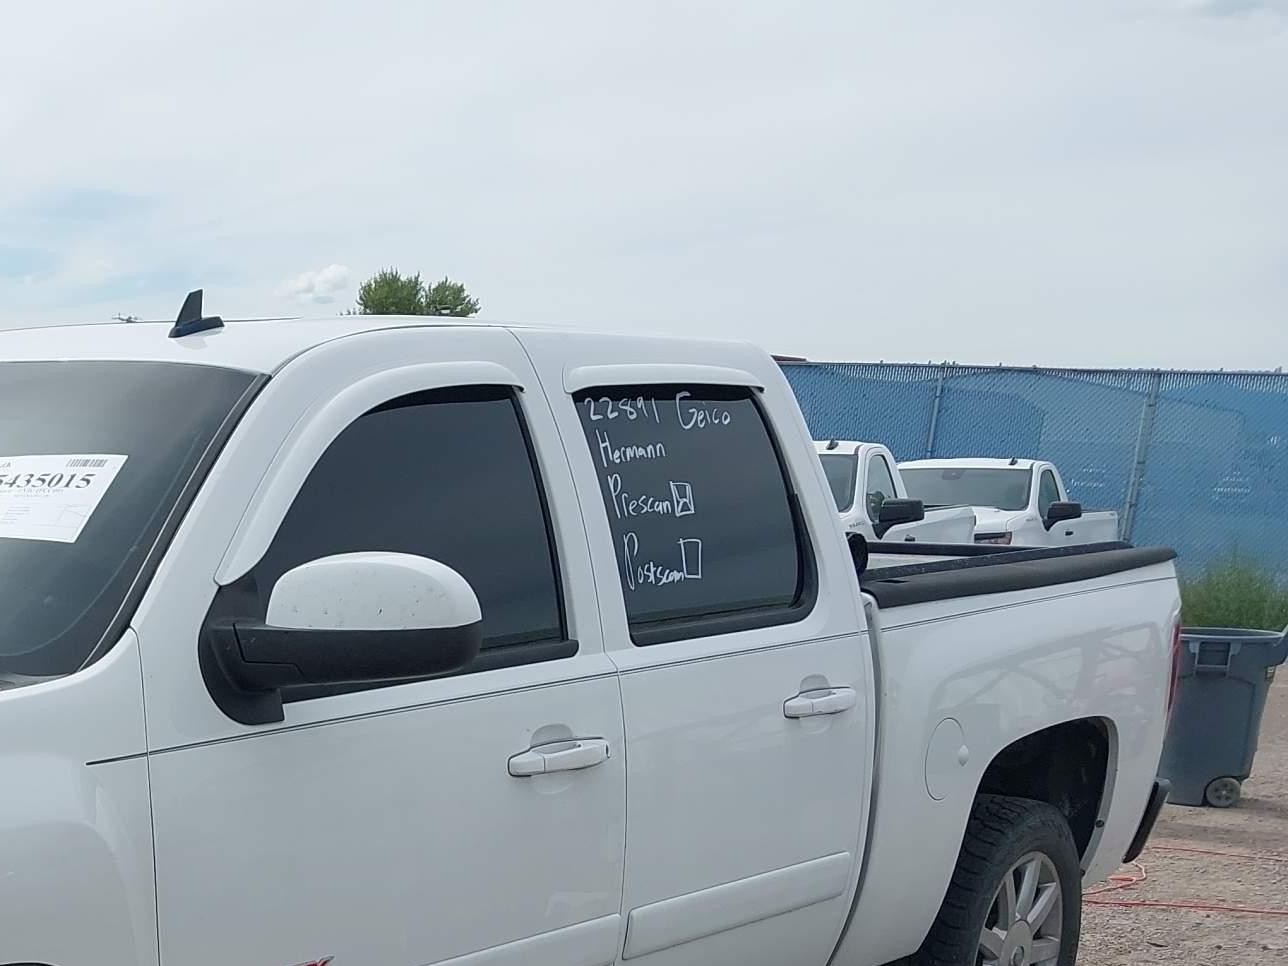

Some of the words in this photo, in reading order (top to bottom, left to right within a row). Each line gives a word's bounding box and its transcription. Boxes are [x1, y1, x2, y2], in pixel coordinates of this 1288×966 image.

[584, 396, 660, 424] 22891
[676, 391, 731, 429] Geico
[595, 429, 666, 468] Hermann
[607, 473, 672, 519] Prescan
